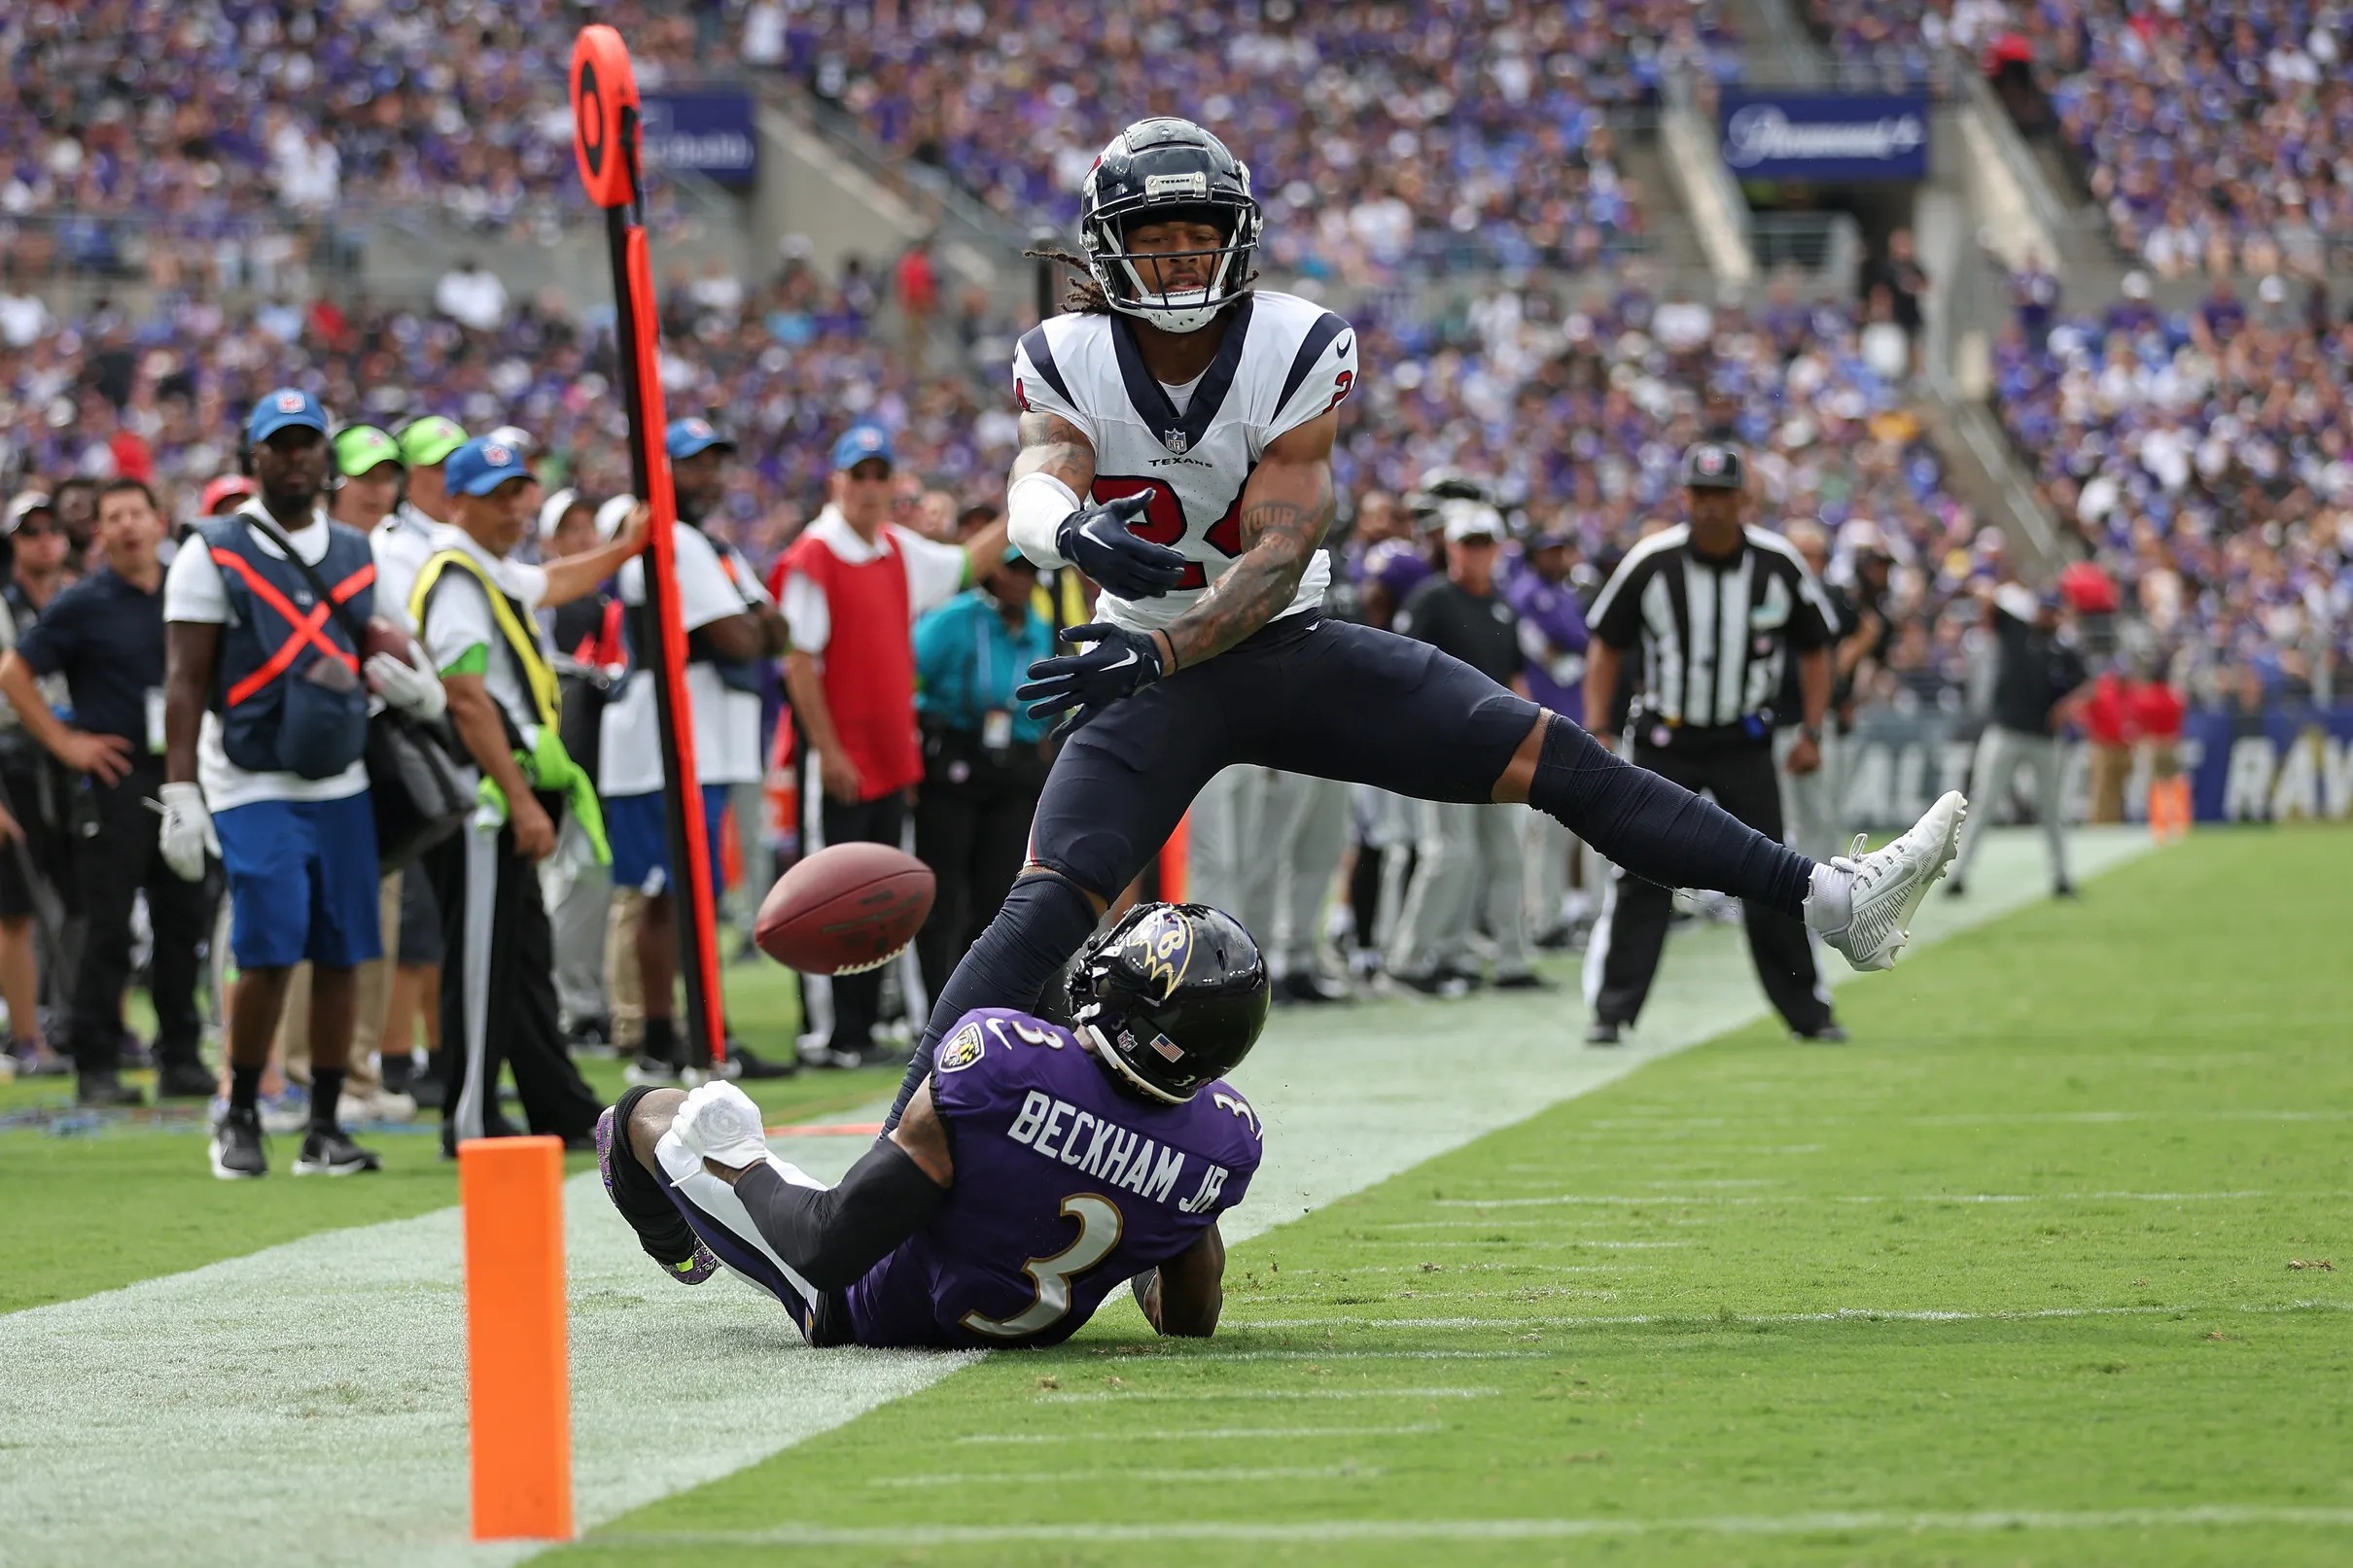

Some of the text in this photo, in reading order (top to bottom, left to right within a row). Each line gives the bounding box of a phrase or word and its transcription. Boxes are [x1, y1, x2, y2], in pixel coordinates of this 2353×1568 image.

[1147, 457, 1213, 468] TEXANS
[1244, 506, 1296, 538] YOUR
[1011, 1020, 1065, 1050] 3
[1212, 1092, 1255, 1134] 3
[1007, 1090, 1185, 1202] BECKHAM
[958, 1193, 1123, 1339] 3
